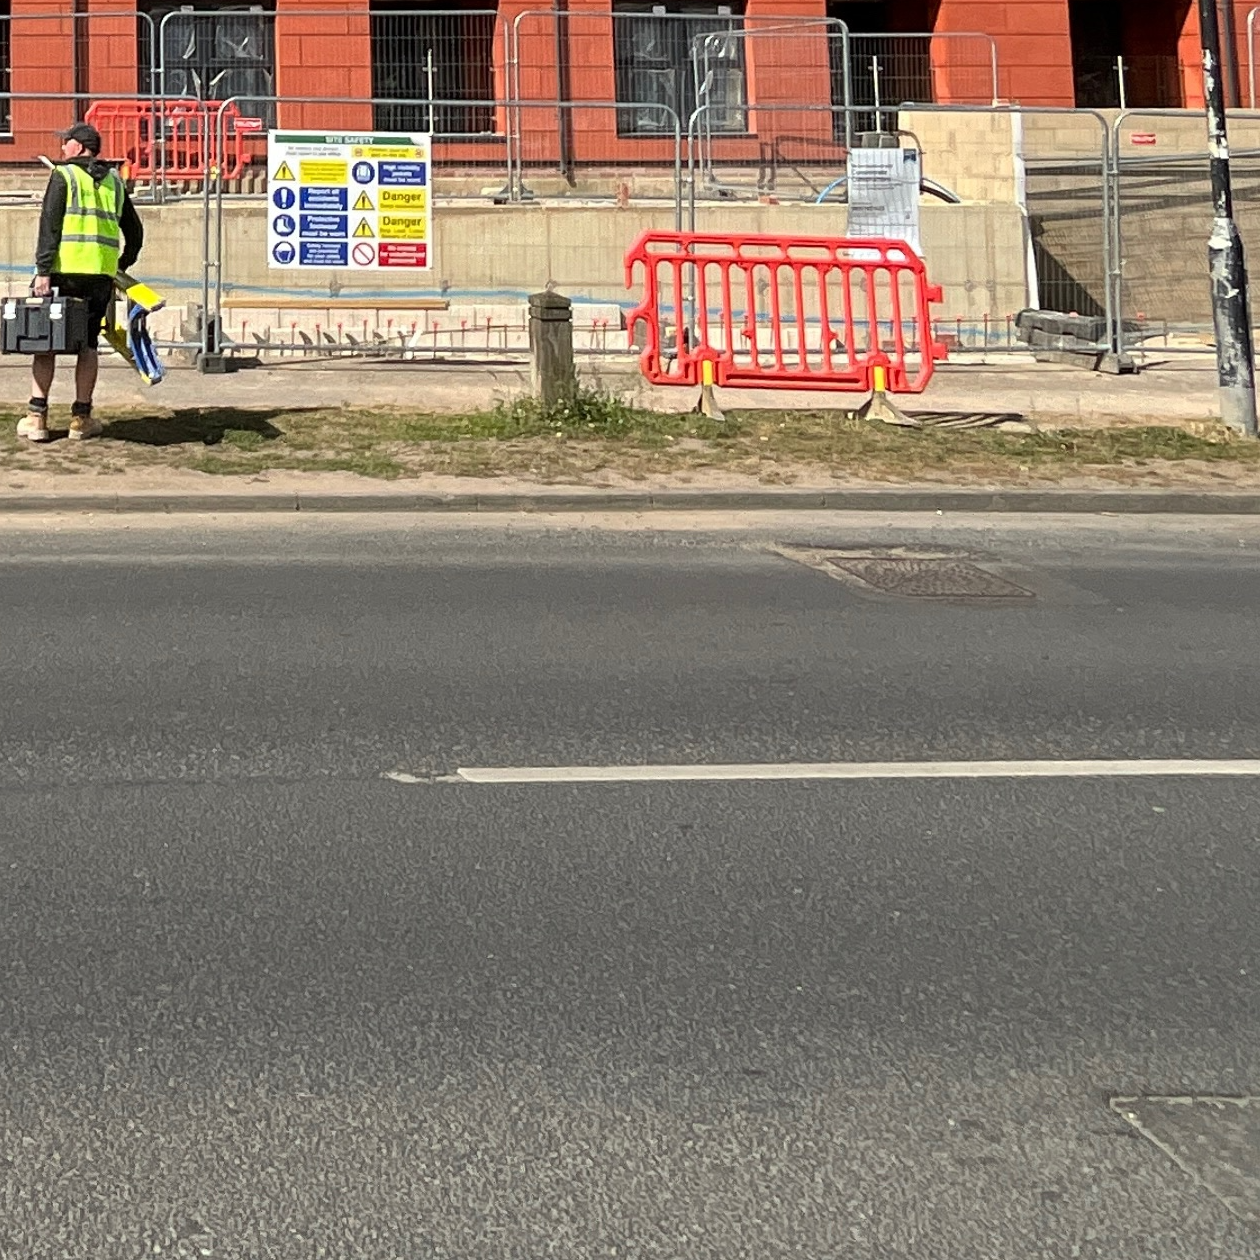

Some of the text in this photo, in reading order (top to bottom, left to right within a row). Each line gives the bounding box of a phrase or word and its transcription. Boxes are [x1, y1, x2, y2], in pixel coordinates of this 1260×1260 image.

[325, 136, 374, 145] SITE SAFETY
[382, 190, 422, 203] Danger
[382, 216, 422, 228] Danger
